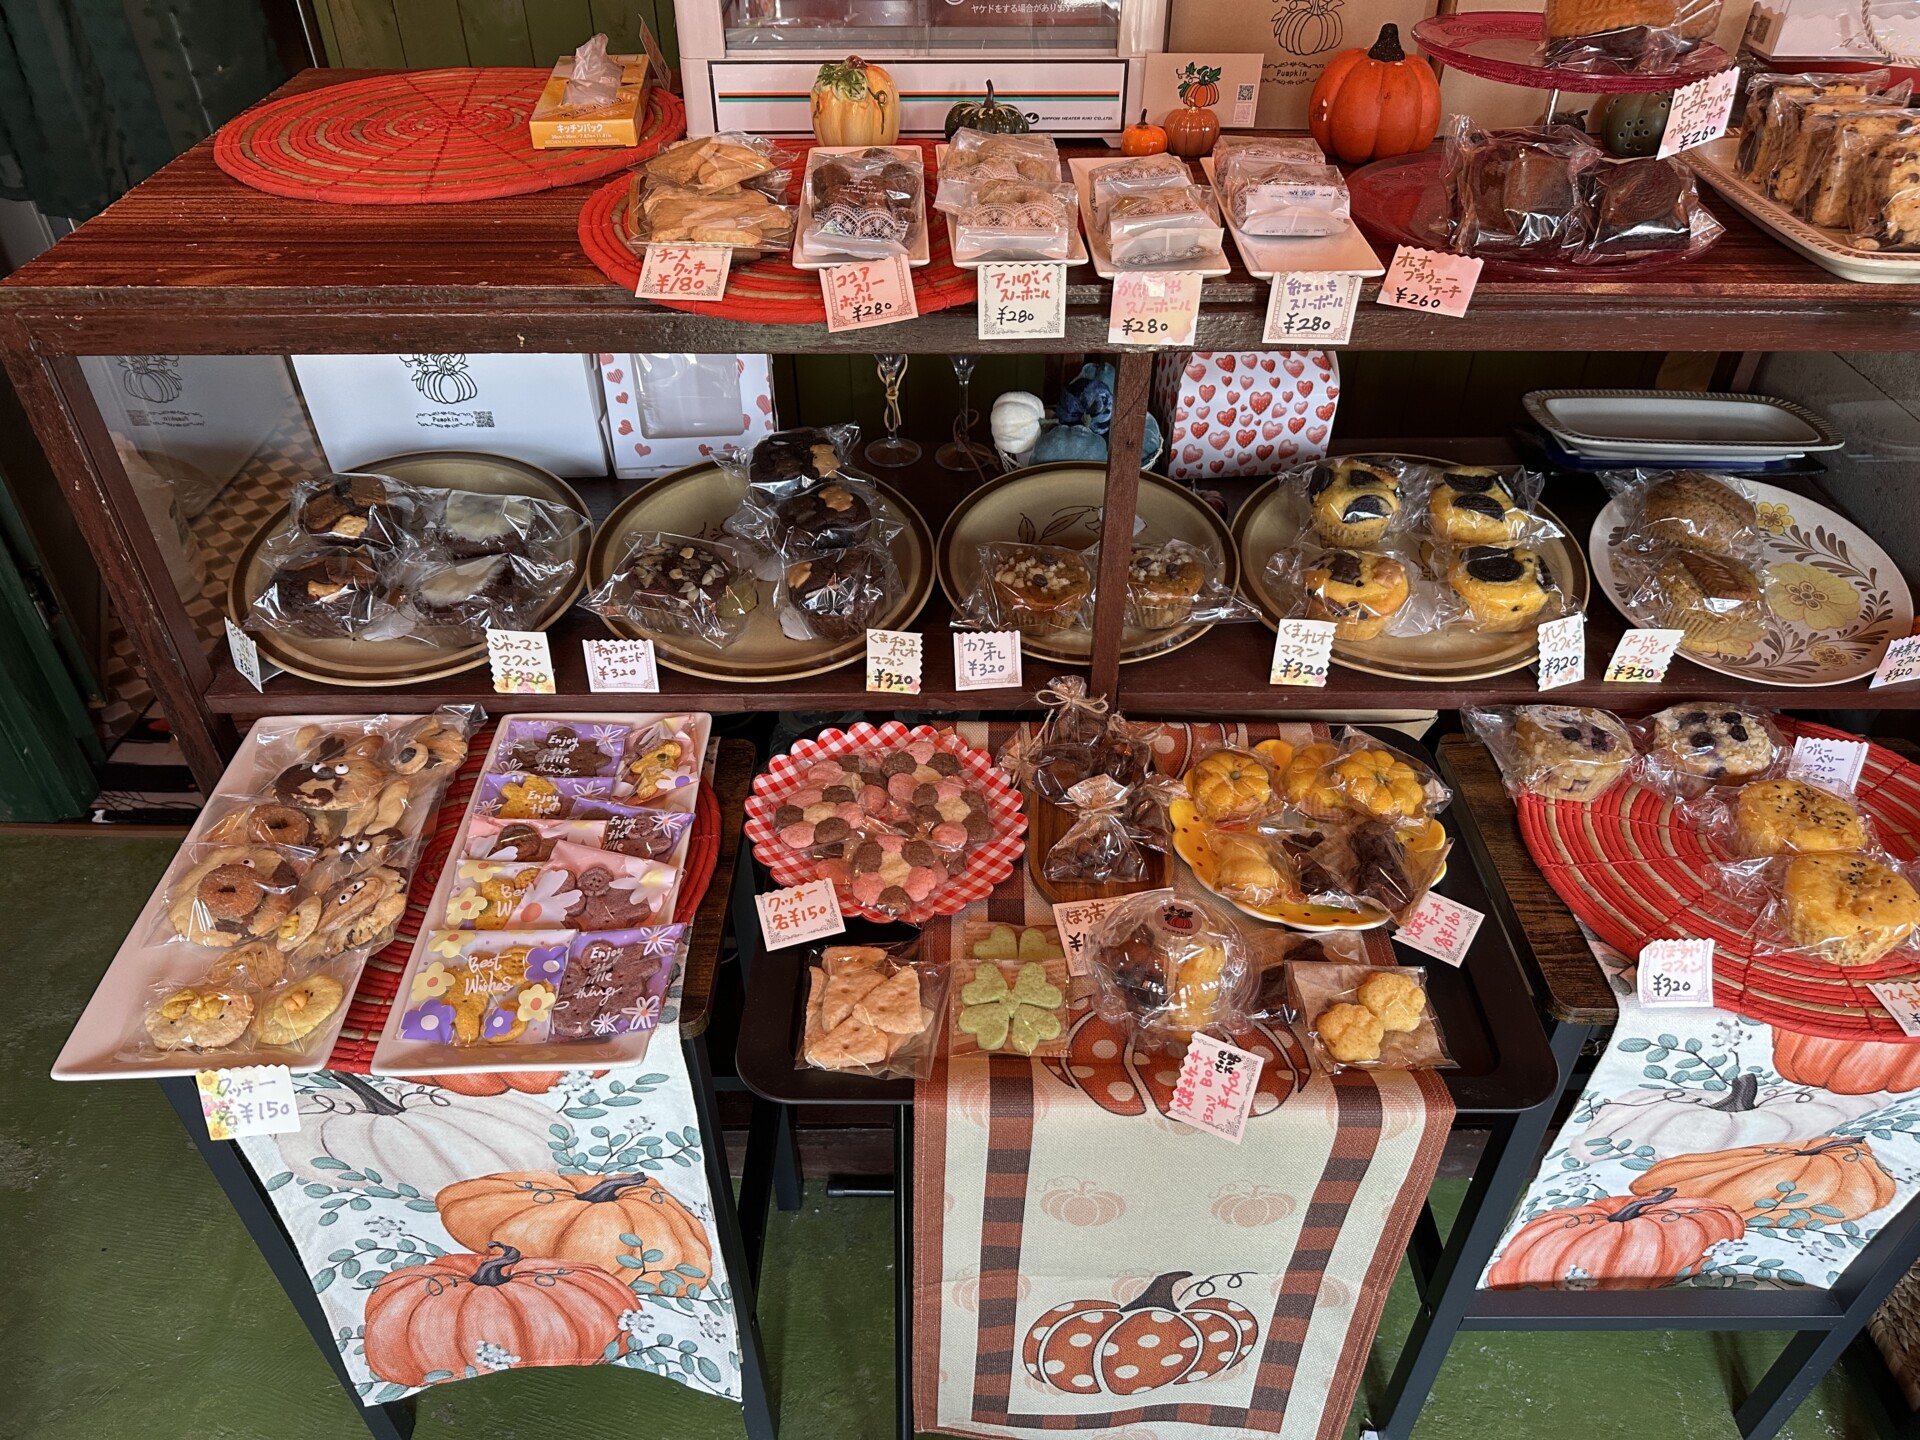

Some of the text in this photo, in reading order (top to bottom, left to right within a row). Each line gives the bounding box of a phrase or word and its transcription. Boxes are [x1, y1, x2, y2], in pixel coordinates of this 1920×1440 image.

[1276, 69, 1307, 78] Pumpkin
[557, 123, 603, 133] キッチンパック
[1679, 126, 1716, 151] ¥260
[673, 261, 718, 277] クッキー
[1396, 252, 1432, 269] オレオ
[656, 274, 704, 293] ¥180
[836, 267, 870, 288] ココア
[991, 270, 1052, 288] アールグレイ
[1404, 268, 1458, 284] ブラウニー
[854, 279, 885, 297] スノー
[1000, 286, 1051, 302] スノーボール
[1429, 285, 1462, 298] ケーキ
[1126, 297, 1191, 314] スノーボール
[1290, 294, 1343, 311] スノーボール
[1396, 287, 1441, 308] ¥260
[852, 302, 892, 322] ¥280
[996, 305, 1034, 325] ¥280
[1122, 317, 1168, 335] ¥280
[1283, 312, 1331, 334] ¥280
[1541, 620, 1569, 643] オレオ
[491, 634, 543, 651] ジャーマン
[964, 638, 996, 651] カフェ
[1281, 644, 1319, 657] マフィン
[499, 655, 541, 667] マフィン
[603, 652, 645, 666] アーモンド
[870, 656, 904, 667] マフィン
[983, 650, 1006, 661] オレ
[597, 666, 637, 680] ¥320
[968, 659, 1005, 677] ¥320
[1280, 658, 1324, 678] ¥320
[1544, 656, 1579, 678] ¥320
[1614, 665, 1654, 680] ¥320
[501, 668, 547, 688] ¥320
[874, 668, 913, 689] ¥320
[548, 735, 579, 751] Enjoy
[550, 747, 569, 755] the
[1805, 743, 1832, 755] ブルー
[541, 755, 571, 764] little
[1815, 754, 1845, 763] ベリー
[534, 763, 579, 776] things
[527, 790, 561, 811] Enjoy
[529, 803, 551, 815] the
[607, 815, 637, 834] Enjoy
[607, 830, 625, 840] the
[602, 840, 624, 852] ittle
[768, 889, 818, 912] クッキー
[590, 946, 624, 963] Enjoy
[468, 954, 512, 973] Best
[589, 962, 614, 974] the
[1662, 960, 1703, 973] マフィン
[465, 971, 514, 995] Wishes
[584, 973, 613, 986] little
[1653, 973, 1691, 997] ¥320
[573, 986, 623, 1006] things
[1200, 1056, 1215, 1088] BOX
[217, 1078, 276, 1097] クッキー
[1217, 1071, 1241, 1110] ¥400
